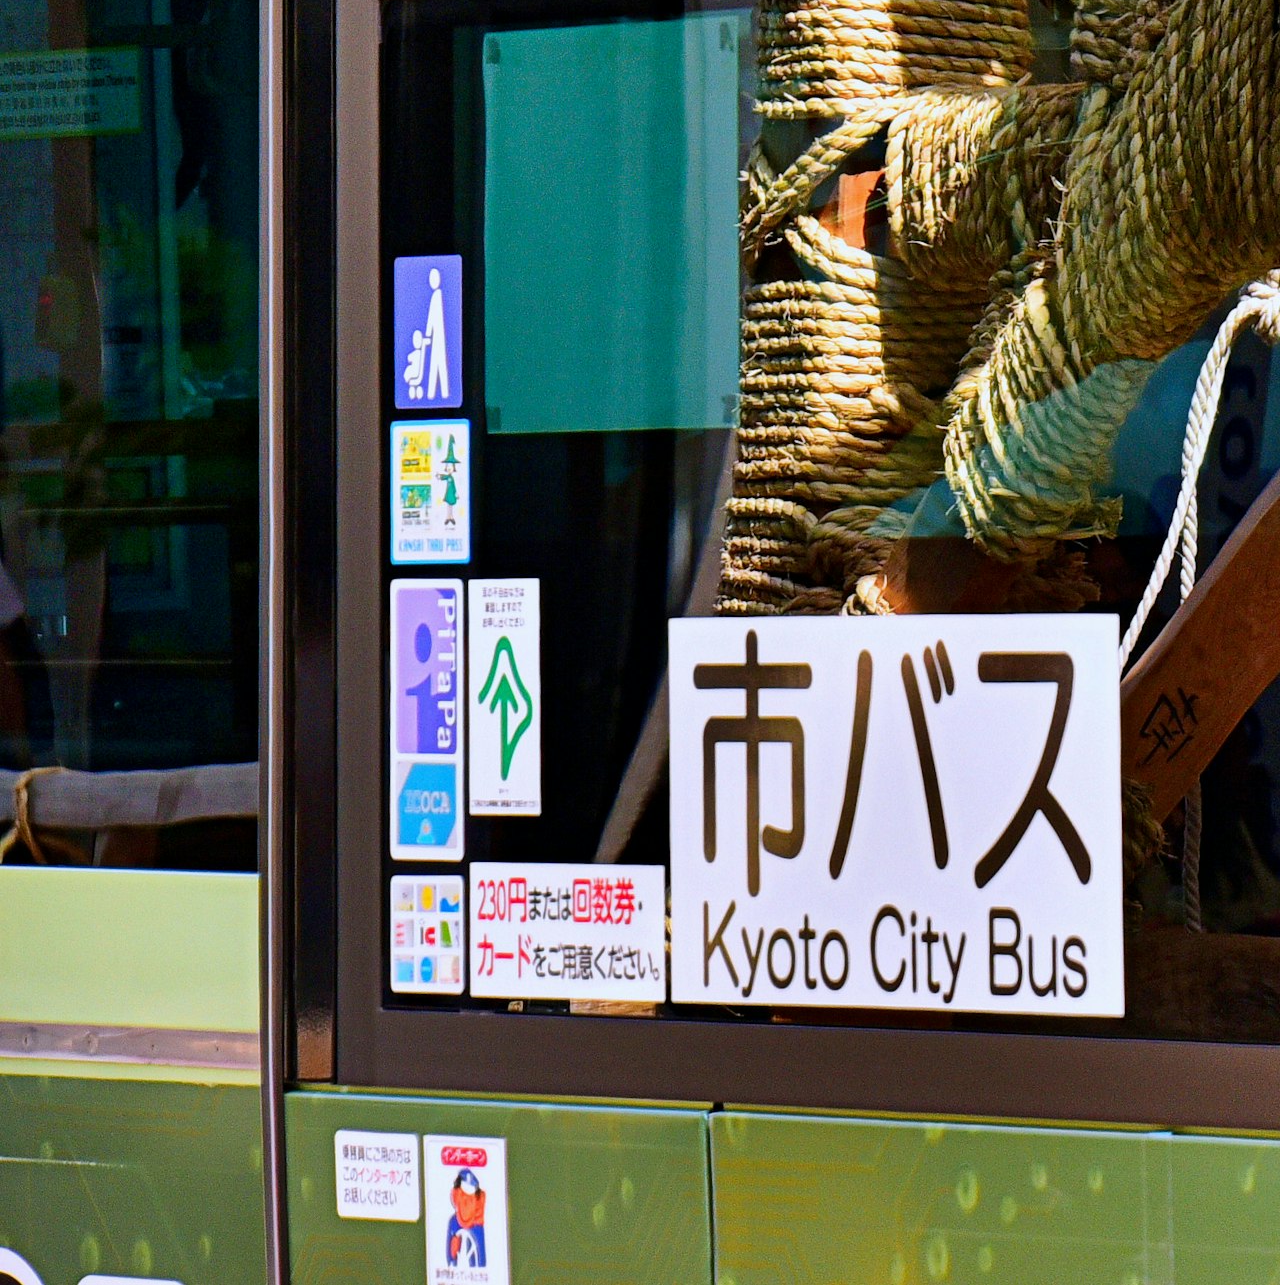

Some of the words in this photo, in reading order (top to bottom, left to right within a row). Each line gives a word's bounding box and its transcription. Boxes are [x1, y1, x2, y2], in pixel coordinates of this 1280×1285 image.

[437, 597, 457, 750] PiTaPa
[693, 628, 1092, 897] 市バス
[477, 934, 660, 982] カードをご用意ください。
[703, 900, 849, 997] Kyoto
[870, 903, 967, 1003] City
[988, 906, 1088, 997] Bus
